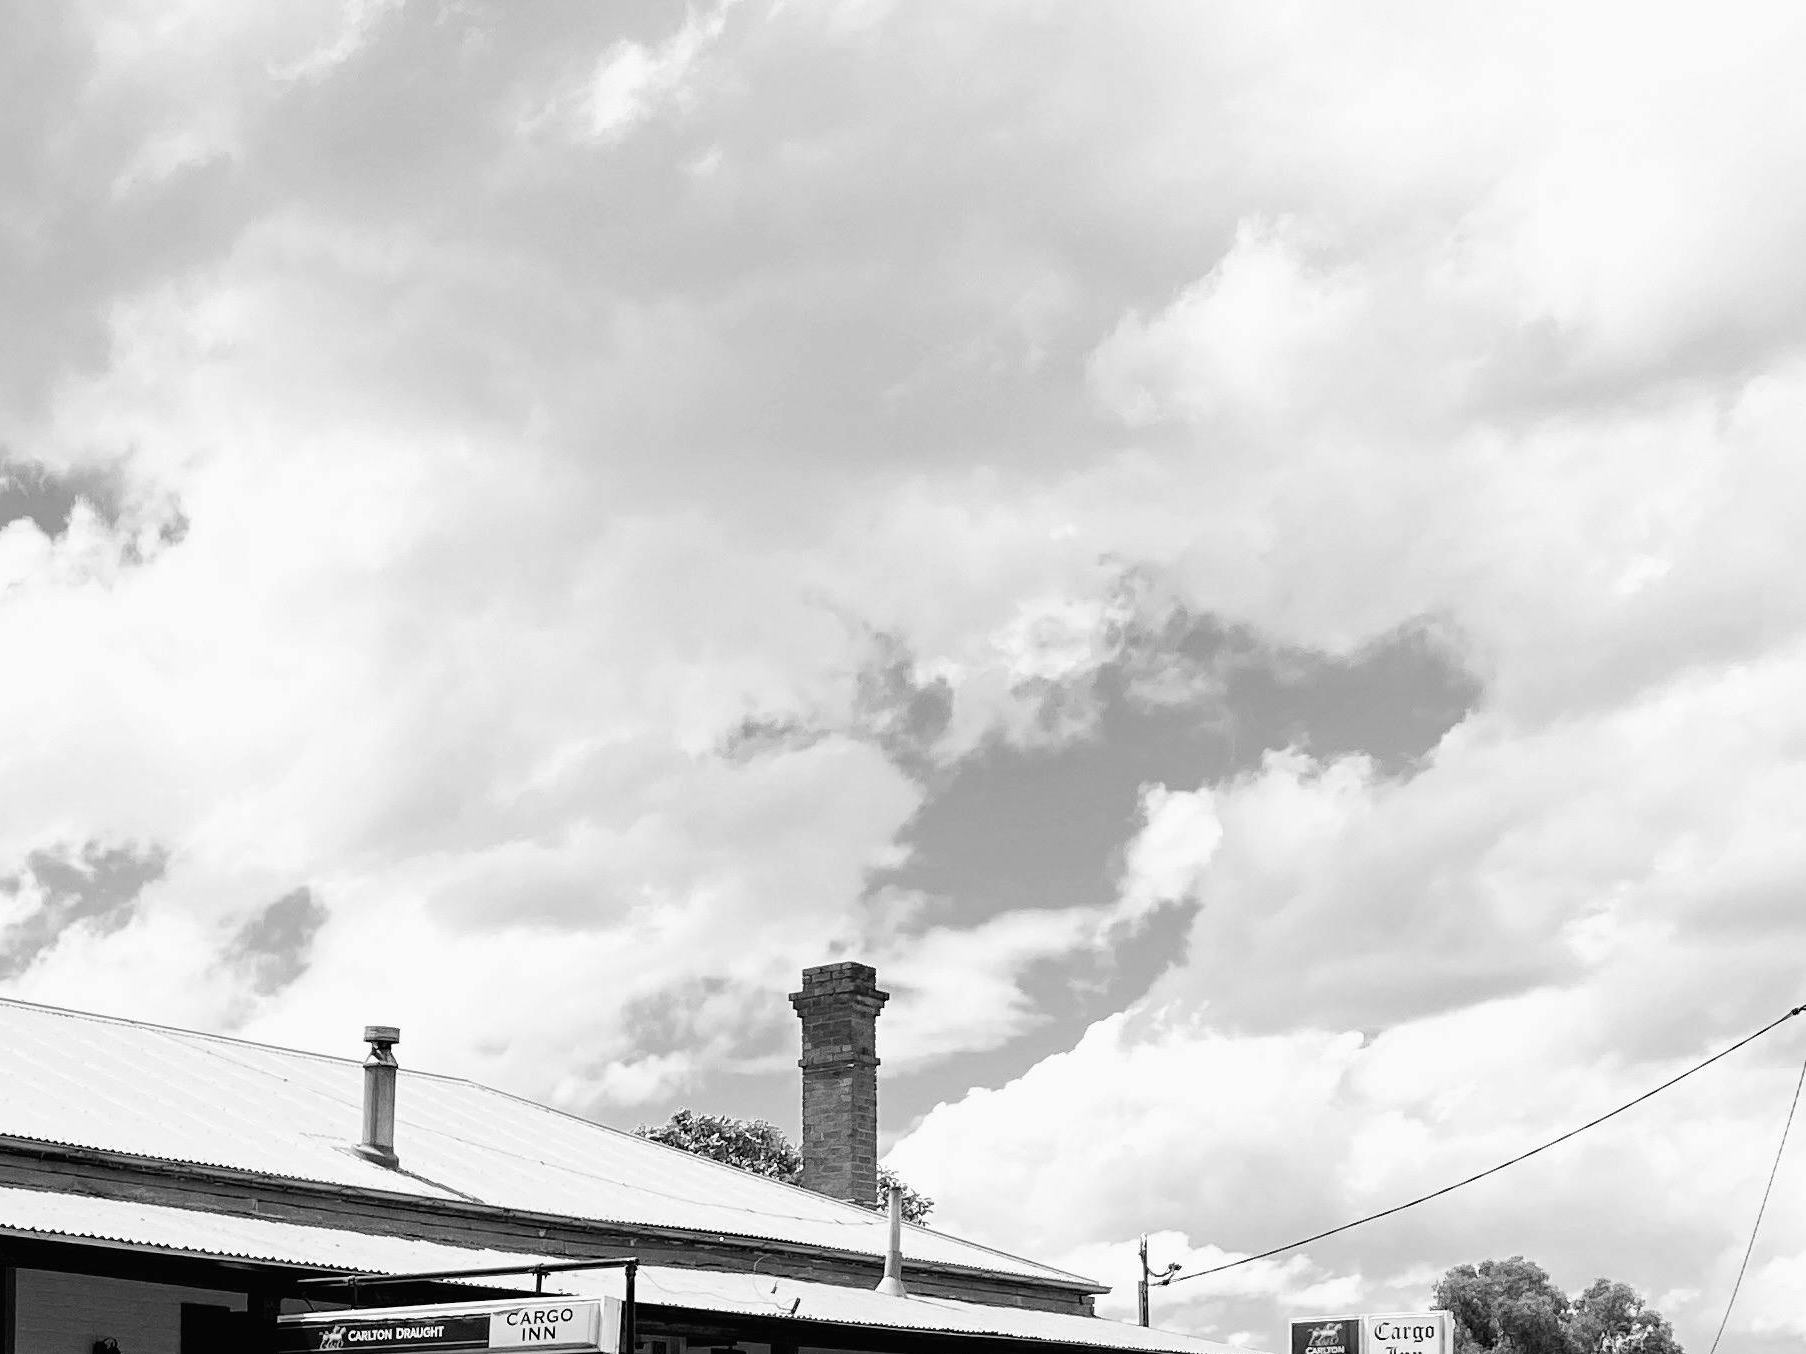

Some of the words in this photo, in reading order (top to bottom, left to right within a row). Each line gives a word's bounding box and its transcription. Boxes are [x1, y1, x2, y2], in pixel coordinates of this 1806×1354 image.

[507, 1308, 573, 1326] CARGO
[348, 1329, 393, 1342] CARLTON
[396, 1326, 445, 1340] DRAUGHT
[522, 1326, 555, 1341] INN
[1374, 1322, 1435, 1343] Cargo
[1305, 1345, 1345, 1354] CARLTON
